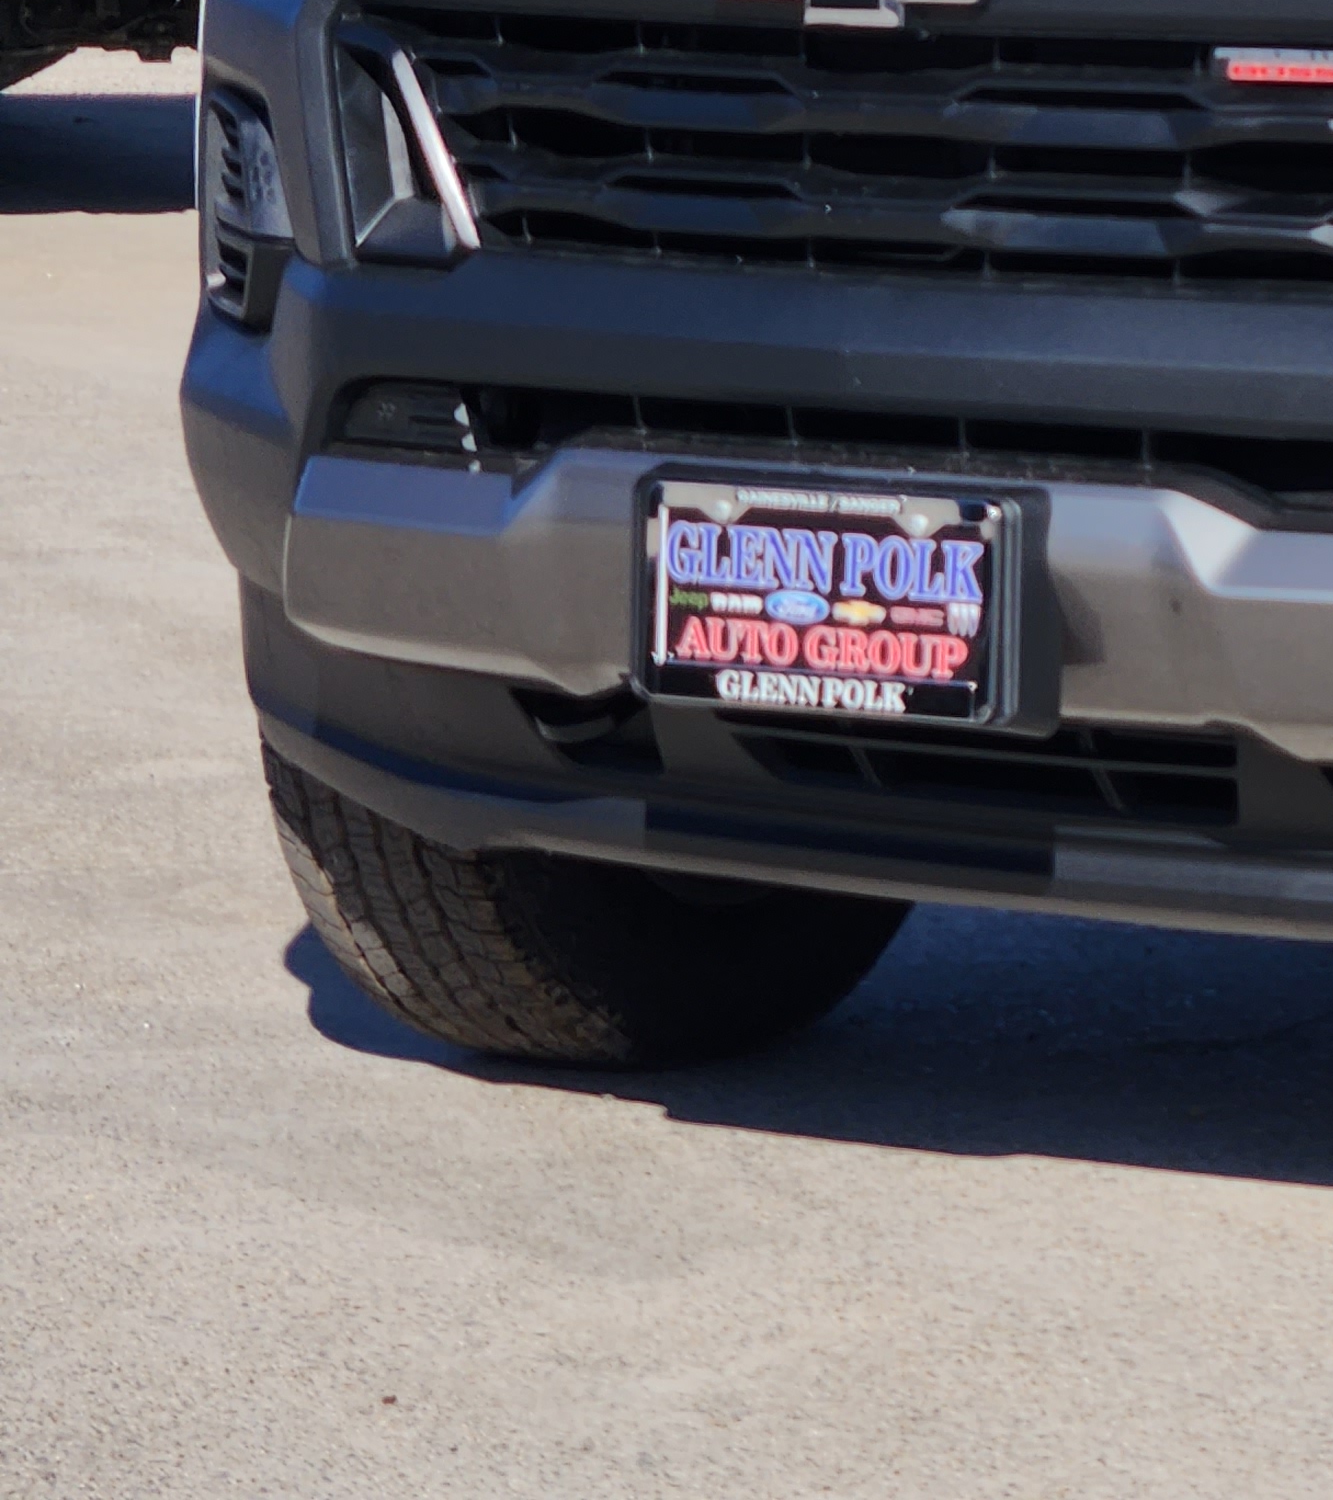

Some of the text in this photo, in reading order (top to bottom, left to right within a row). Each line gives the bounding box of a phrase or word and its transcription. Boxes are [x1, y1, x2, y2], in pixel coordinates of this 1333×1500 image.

[667, 519, 985, 604] GLENN POLK
[675, 615, 969, 680] AUTO GROUP
[715, 669, 907, 713] GLENN POLK
